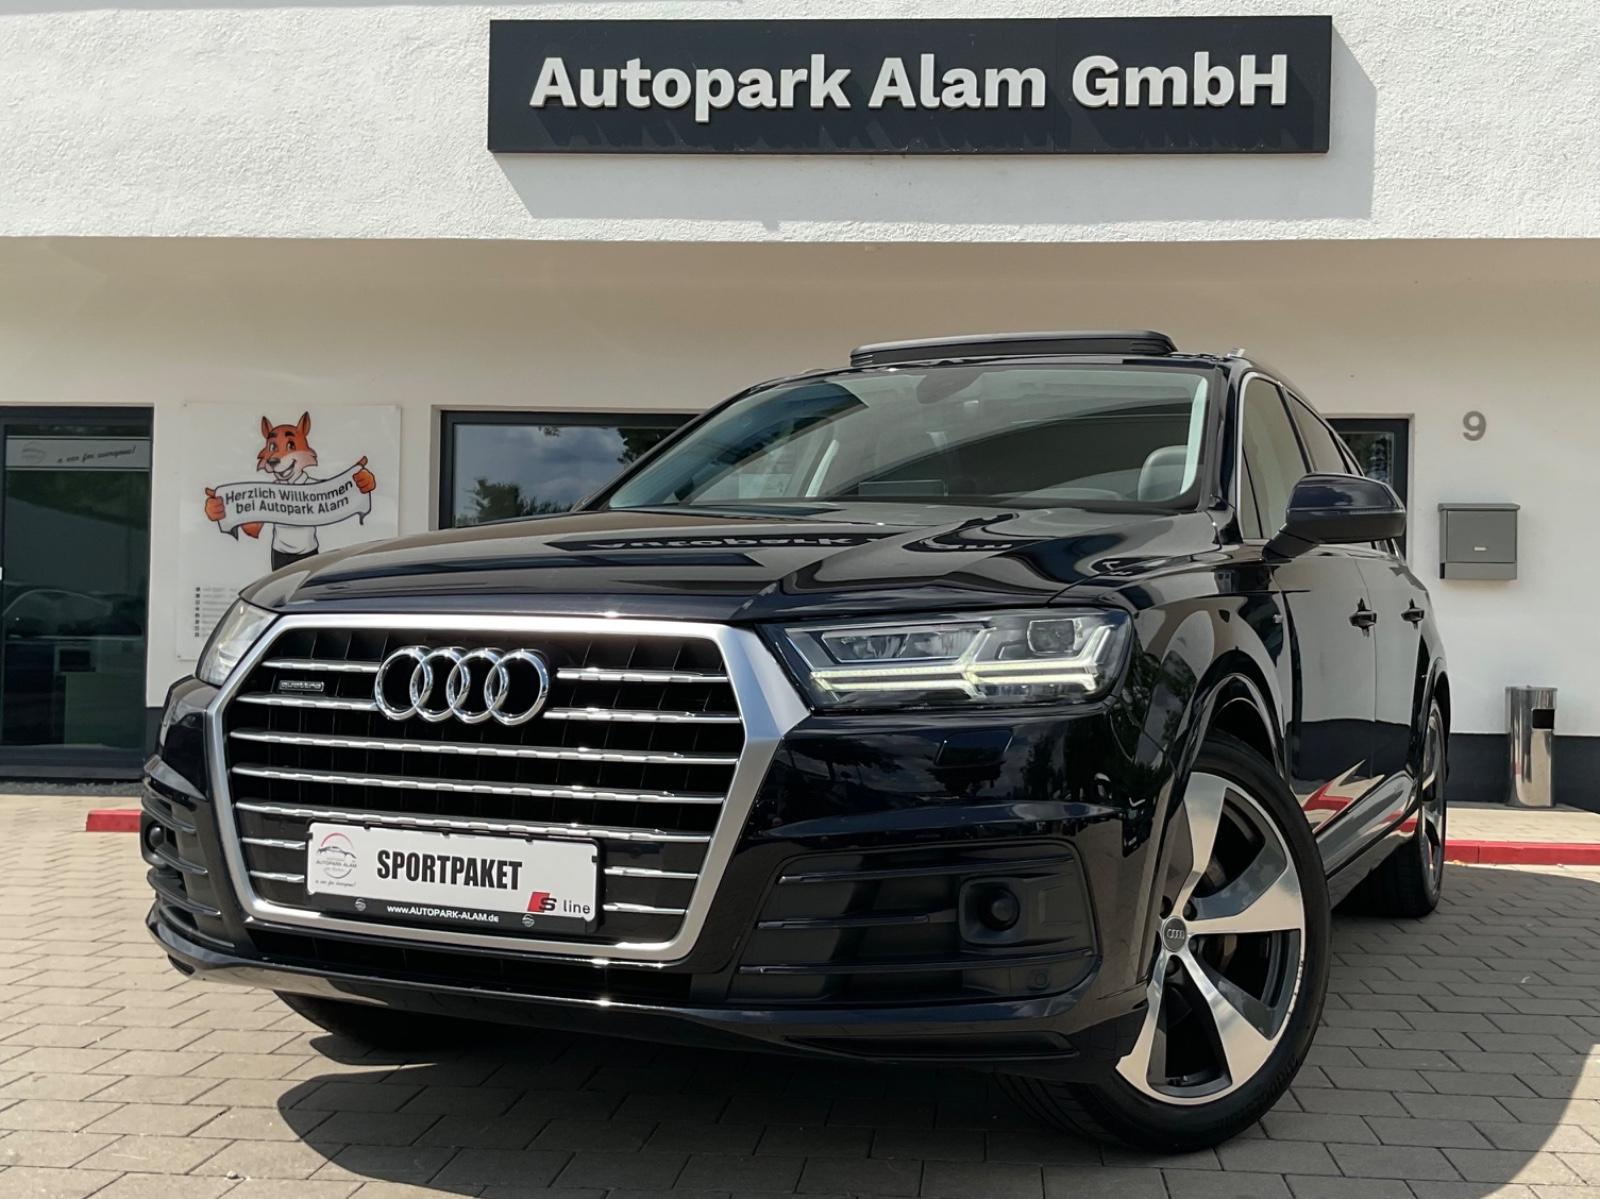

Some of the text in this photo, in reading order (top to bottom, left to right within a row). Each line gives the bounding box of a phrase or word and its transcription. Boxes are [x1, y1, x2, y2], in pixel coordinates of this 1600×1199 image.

[529, 51, 1288, 123] Autopark Alam GmbH
[1462, 410, 1487, 442] 9
[225, 480, 353, 505] Herzlich Willkommen
[236, 497, 349, 516] bei Autopark Alam
[376, 850, 523, 890] SPORTPAKET
[386, 905, 500, 923] www.AUTOPARK-ALAM.de
[563, 899, 591, 914] line
